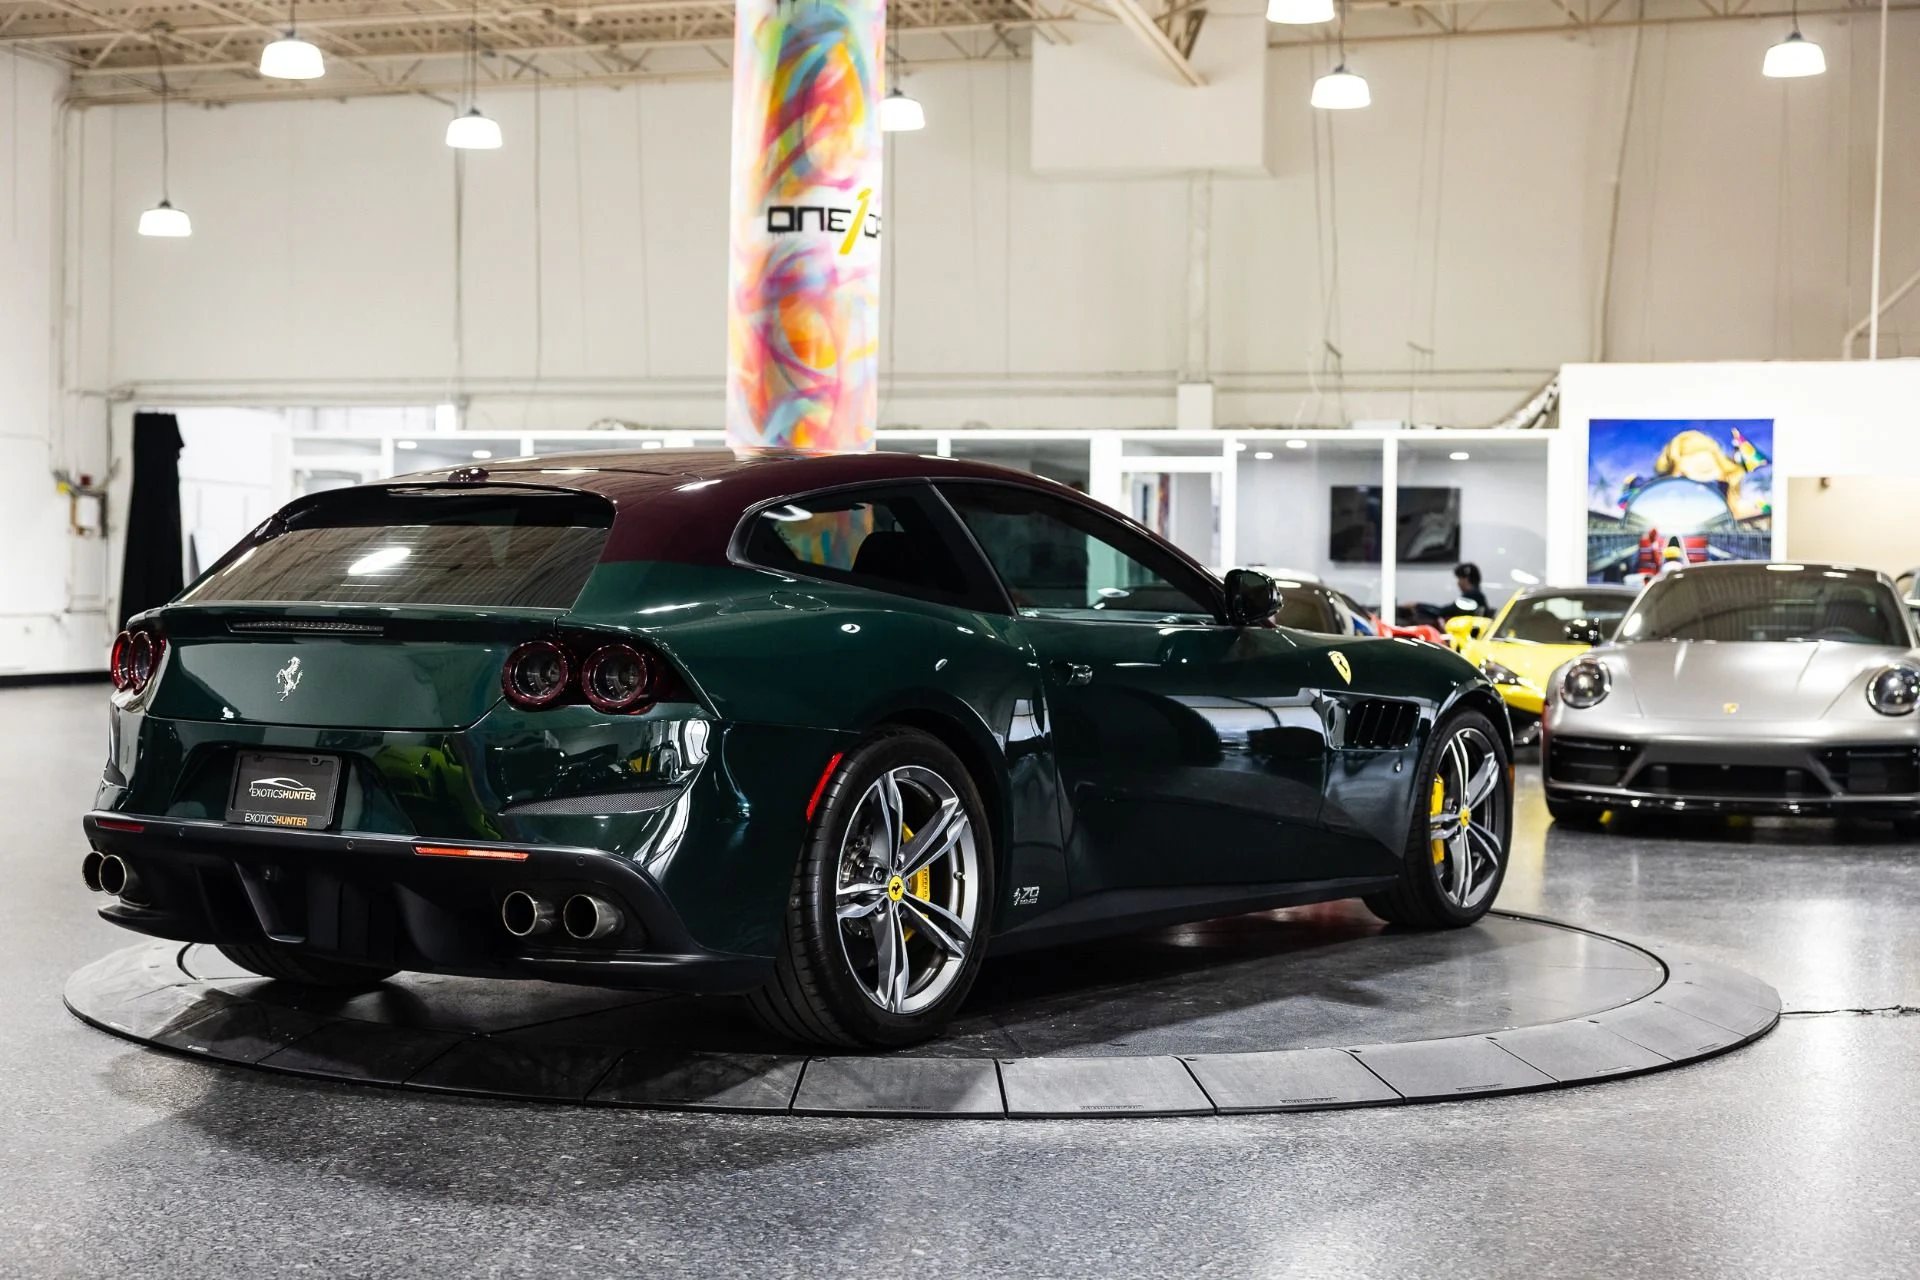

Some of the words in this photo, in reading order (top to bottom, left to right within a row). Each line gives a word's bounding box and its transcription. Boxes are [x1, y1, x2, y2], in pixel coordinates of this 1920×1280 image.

[250, 788, 317, 801] EXOTICSHUNTER
[244, 813, 308, 827] EXOTICSHUNTER
[1020, 886, 1040, 899] 70
